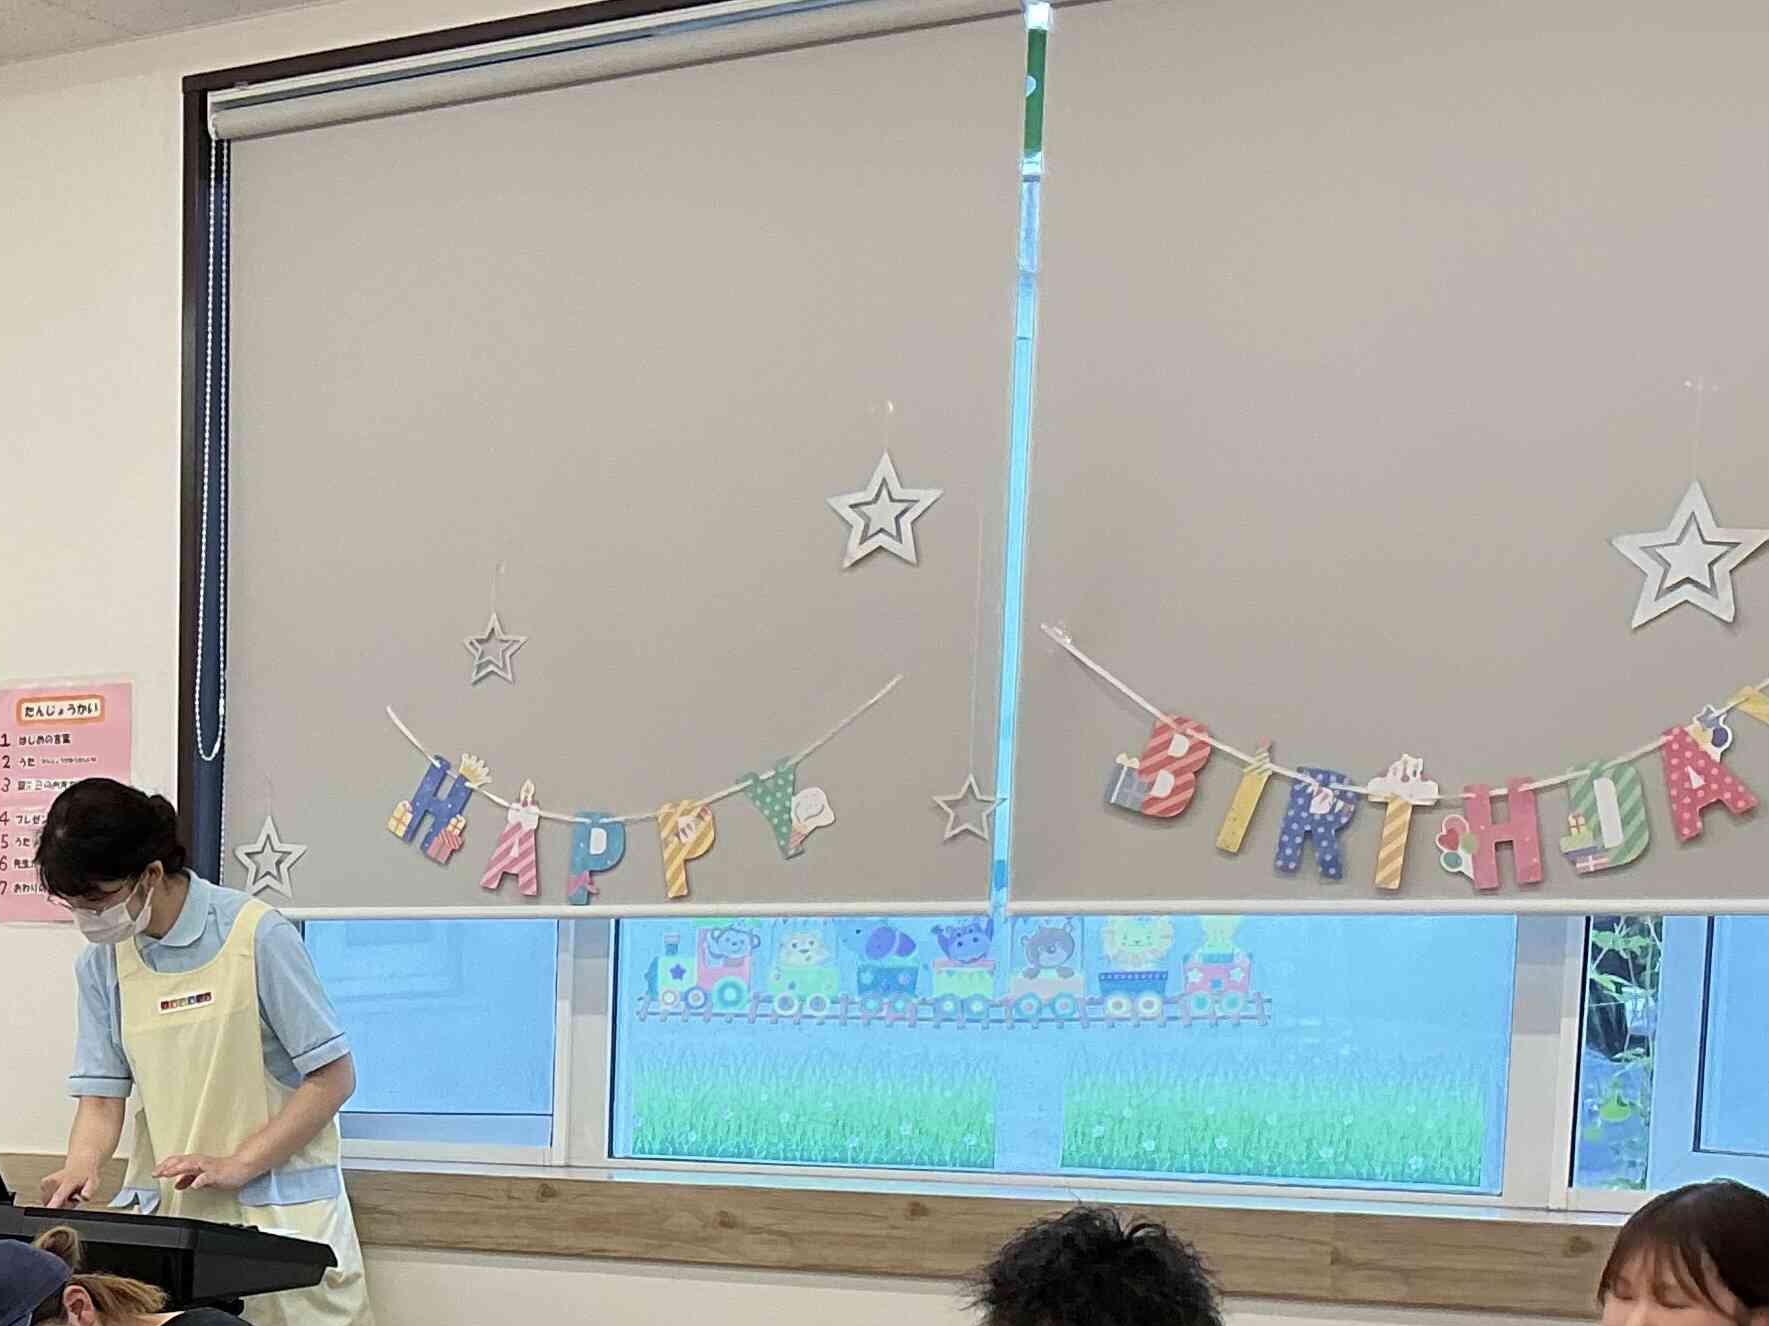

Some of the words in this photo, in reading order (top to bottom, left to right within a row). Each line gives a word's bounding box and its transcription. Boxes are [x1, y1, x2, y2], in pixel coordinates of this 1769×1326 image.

[24, 702, 99, 718] たんじょうかい
[0, 733, 11, 748] 1
[18, 733, 71, 746] はじめの言葉
[1, 755, 11, 769] 2
[19, 757, 36, 768] うた
[1, 777, 11, 793] 3
[392, 755, 817, 905] HAPPY
[1, 833, 9, 849] 5
[16, 837, 31, 847] うた
[0, 855, 8, 871] 6
